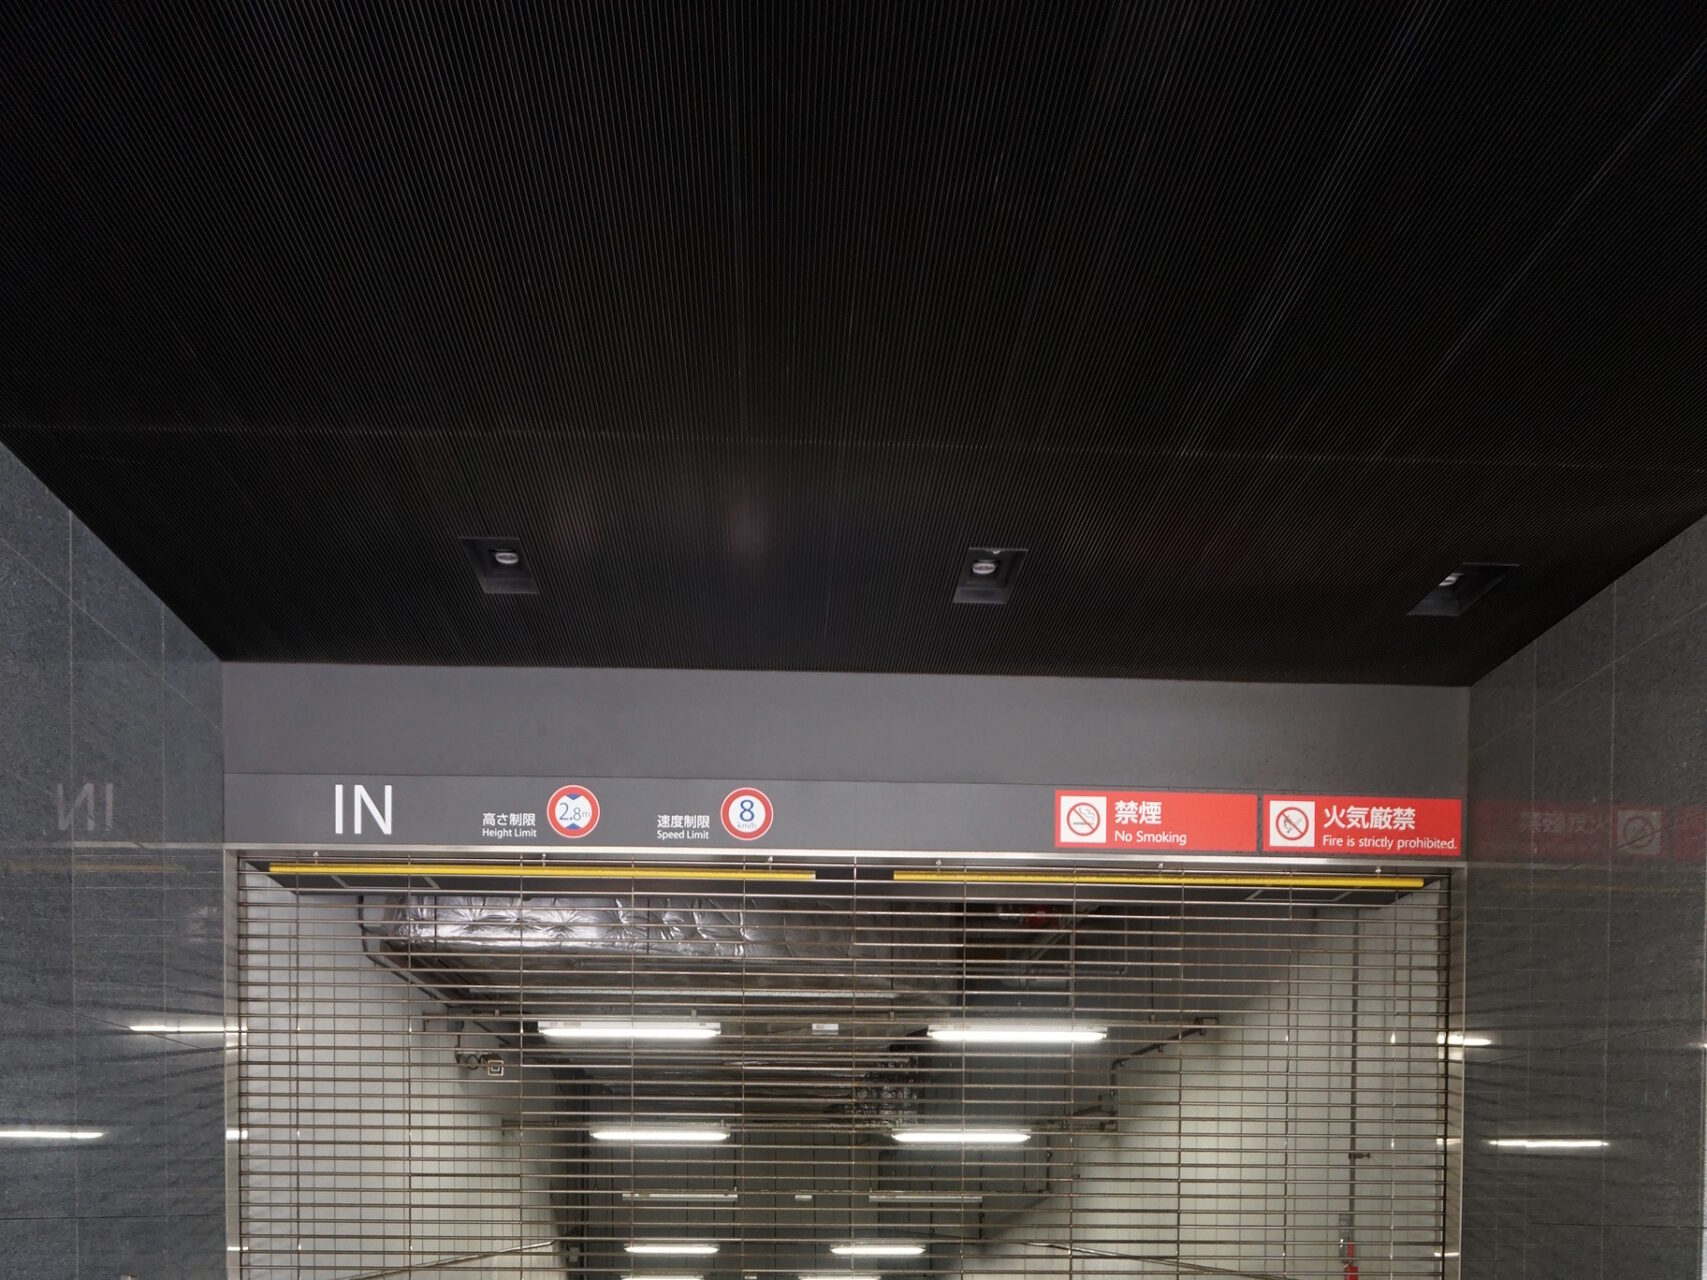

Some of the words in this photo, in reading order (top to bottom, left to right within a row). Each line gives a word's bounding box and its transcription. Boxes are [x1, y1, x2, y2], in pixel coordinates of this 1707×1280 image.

[335, 784, 393, 835] IN
[739, 799, 755, 822] 8
[1114, 799, 1162, 825] 禁煙
[1323, 804, 1416, 831] 火気厳禁
[482, 812, 536, 827] 高さ制限
[657, 814, 710, 829] 速度制限
[482, 828, 513, 839] Height
[514, 828, 537, 838] Limit
[657, 829, 684, 840] Speed
[686, 830, 709, 840] Limit
[1114, 830, 1133, 842] No
[1136, 830, 1187, 846] Smoking
[1322, 834, 1344, 847] Fire
[1346, 835, 1356, 847] is
[1358, 836, 1394, 850] strictly
[1397, 837, 1457, 850] prohibited.
